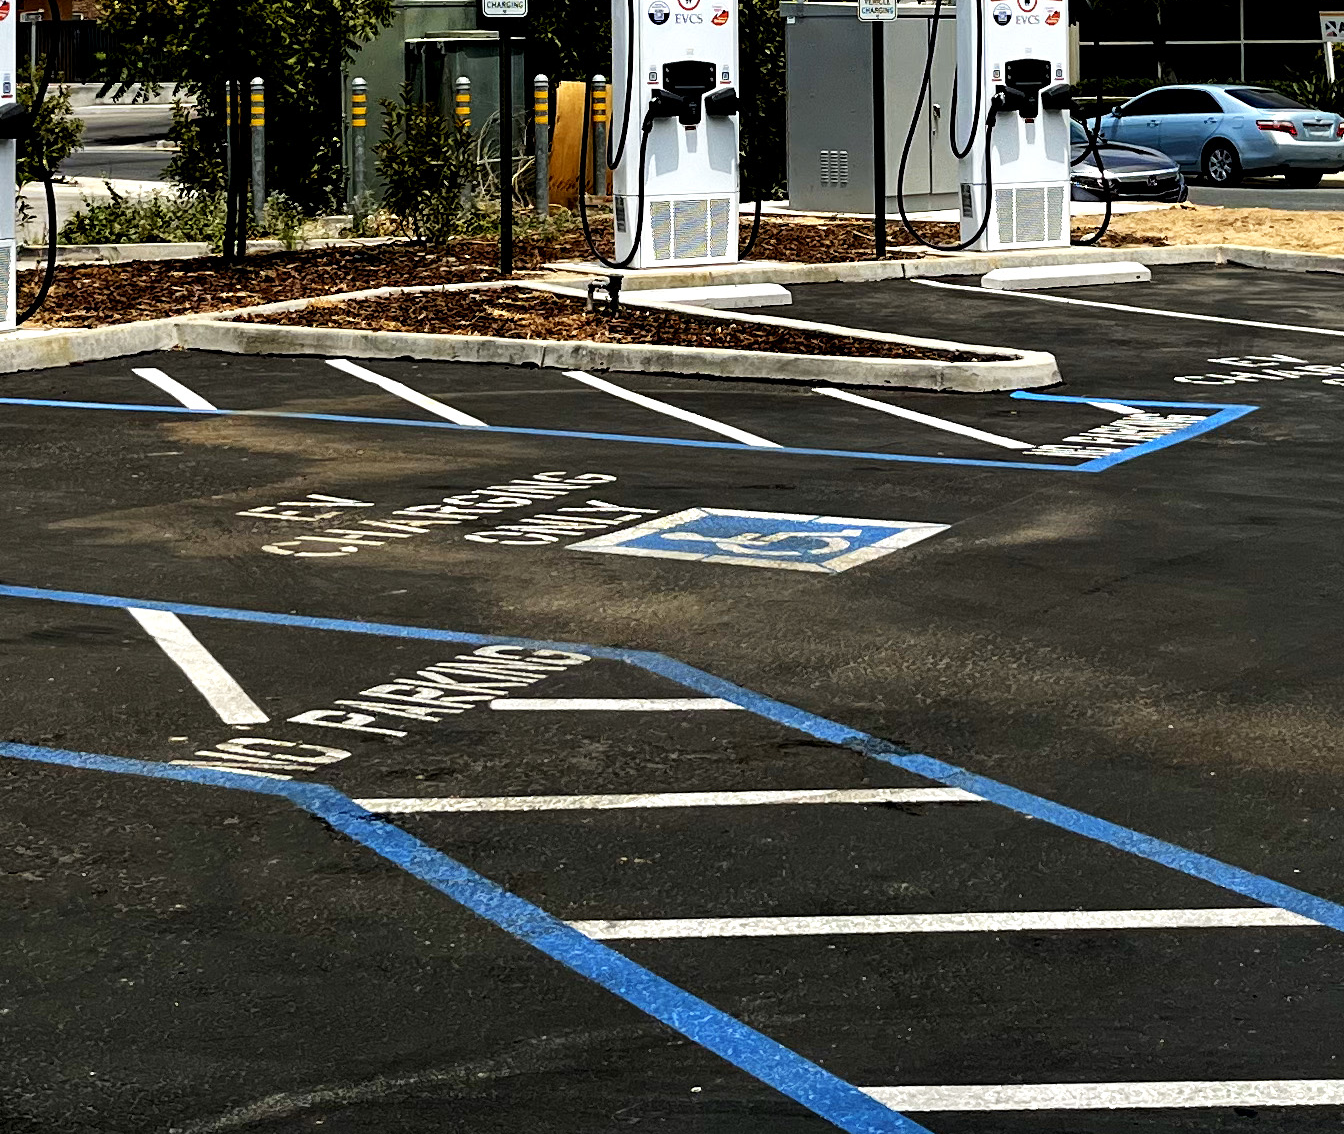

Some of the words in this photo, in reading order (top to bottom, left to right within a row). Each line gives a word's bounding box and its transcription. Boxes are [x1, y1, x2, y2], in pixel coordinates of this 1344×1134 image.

[486, 1, 524, 9] CHARGING
[674, 13, 704, 25] EVCS
[1016, 15, 1041, 25] EVCS
[1206, 354, 1309, 368] EV
[235, 492, 376, 522] EV
[260, 470, 619, 558] CHARGING
[463, 498, 663, 546] ONLY
[169, 736, 352, 780] NO
[286, 644, 592, 737] PARKING
